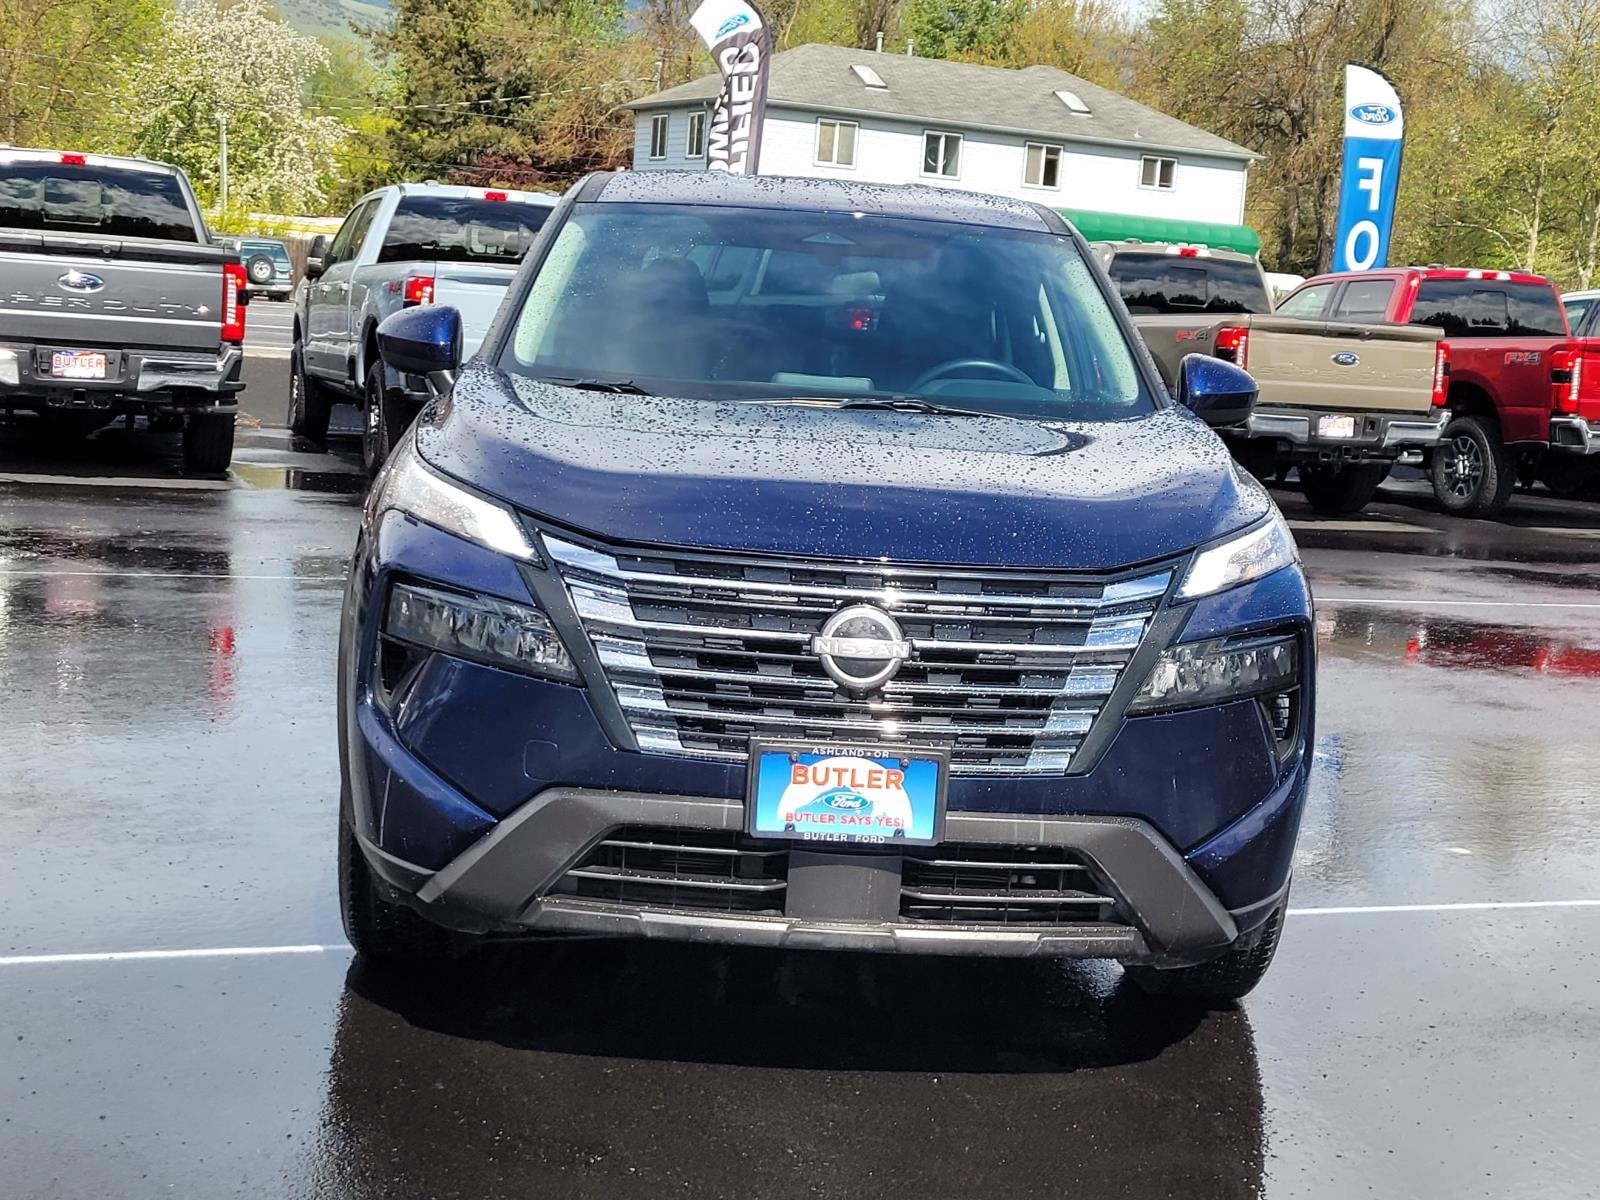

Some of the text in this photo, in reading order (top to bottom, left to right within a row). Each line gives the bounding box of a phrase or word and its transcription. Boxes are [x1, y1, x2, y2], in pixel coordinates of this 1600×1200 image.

[54, 356, 107, 368] BUTLER
[1504, 352, 1541, 365] FX4
[816, 636, 908, 658] NISSAN
[792, 765, 903, 790] BUTLER
[785, 812, 836, 825] BUTLER
[840, 816, 872, 827] SAYS
[803, 832, 885, 844] BUTLER FORD
